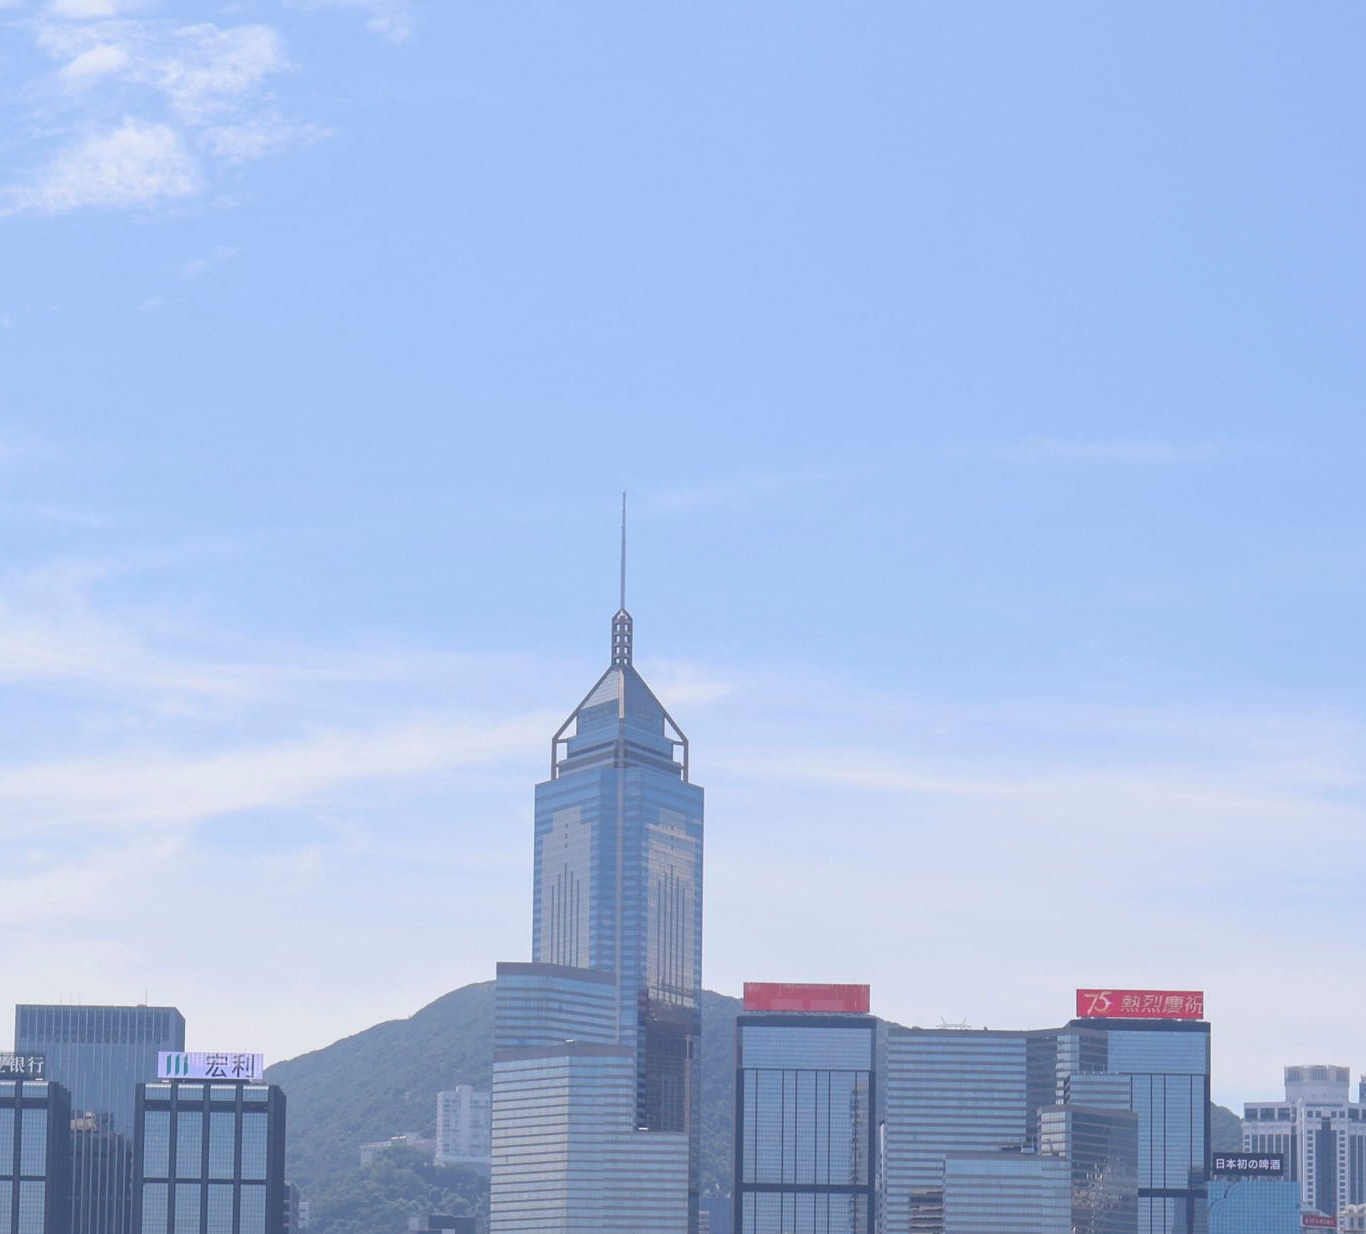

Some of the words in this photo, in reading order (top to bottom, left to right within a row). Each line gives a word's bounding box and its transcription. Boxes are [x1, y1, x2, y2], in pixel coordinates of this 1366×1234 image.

[1083, 991, 1113, 1015] 75
[1120, 994, 1203, 1014] 熱烈慶祝
[205, 1053, 255, 1079] 宏利
